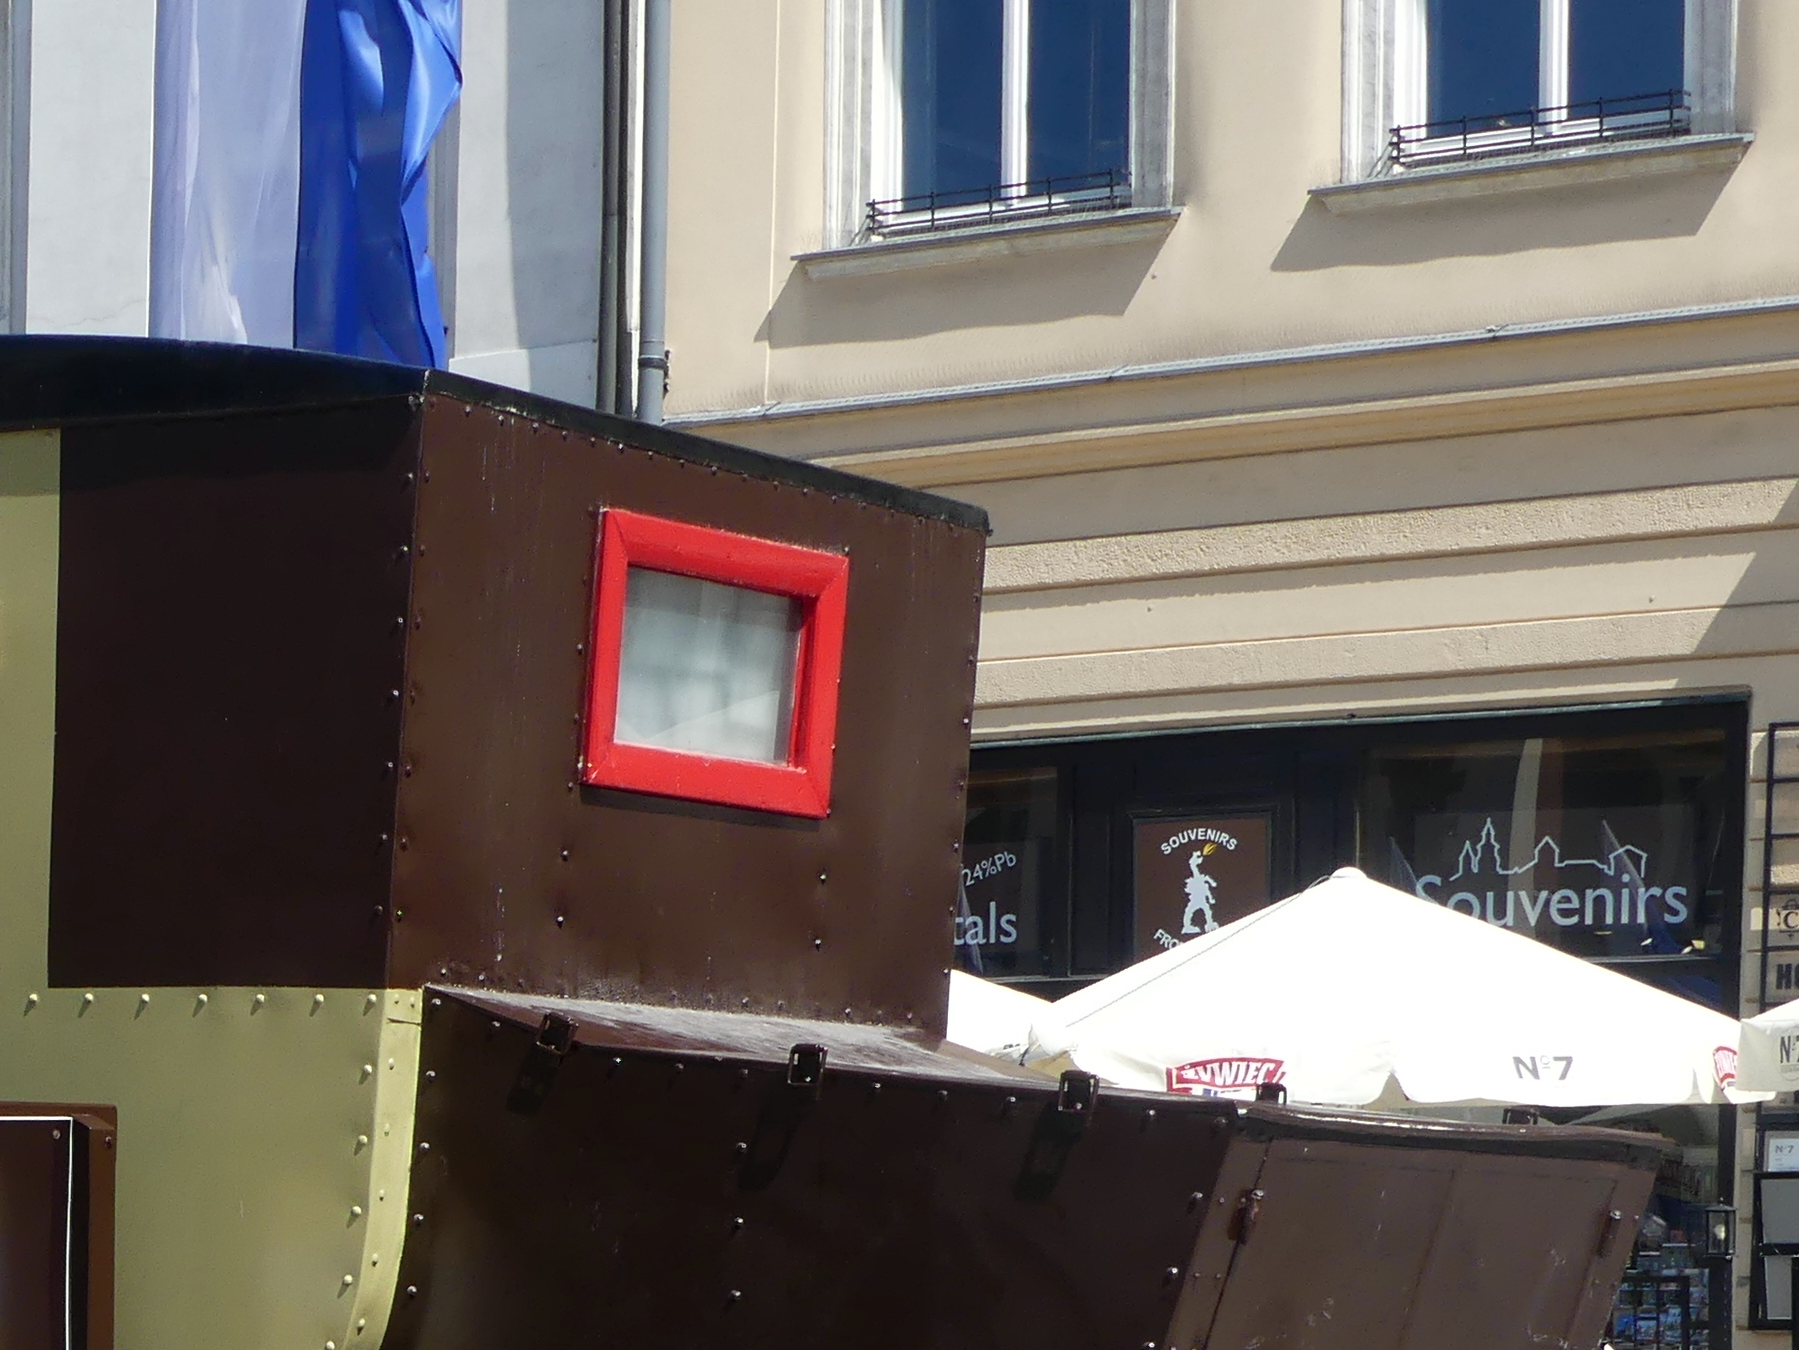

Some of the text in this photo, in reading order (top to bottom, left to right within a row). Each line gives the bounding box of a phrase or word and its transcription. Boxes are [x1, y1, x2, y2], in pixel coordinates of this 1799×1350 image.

[1160, 828, 1238, 856] SOUVENIRS
[1415, 873, 1689, 927] Souvenirs
[1153, 928, 1181, 950] FRO
